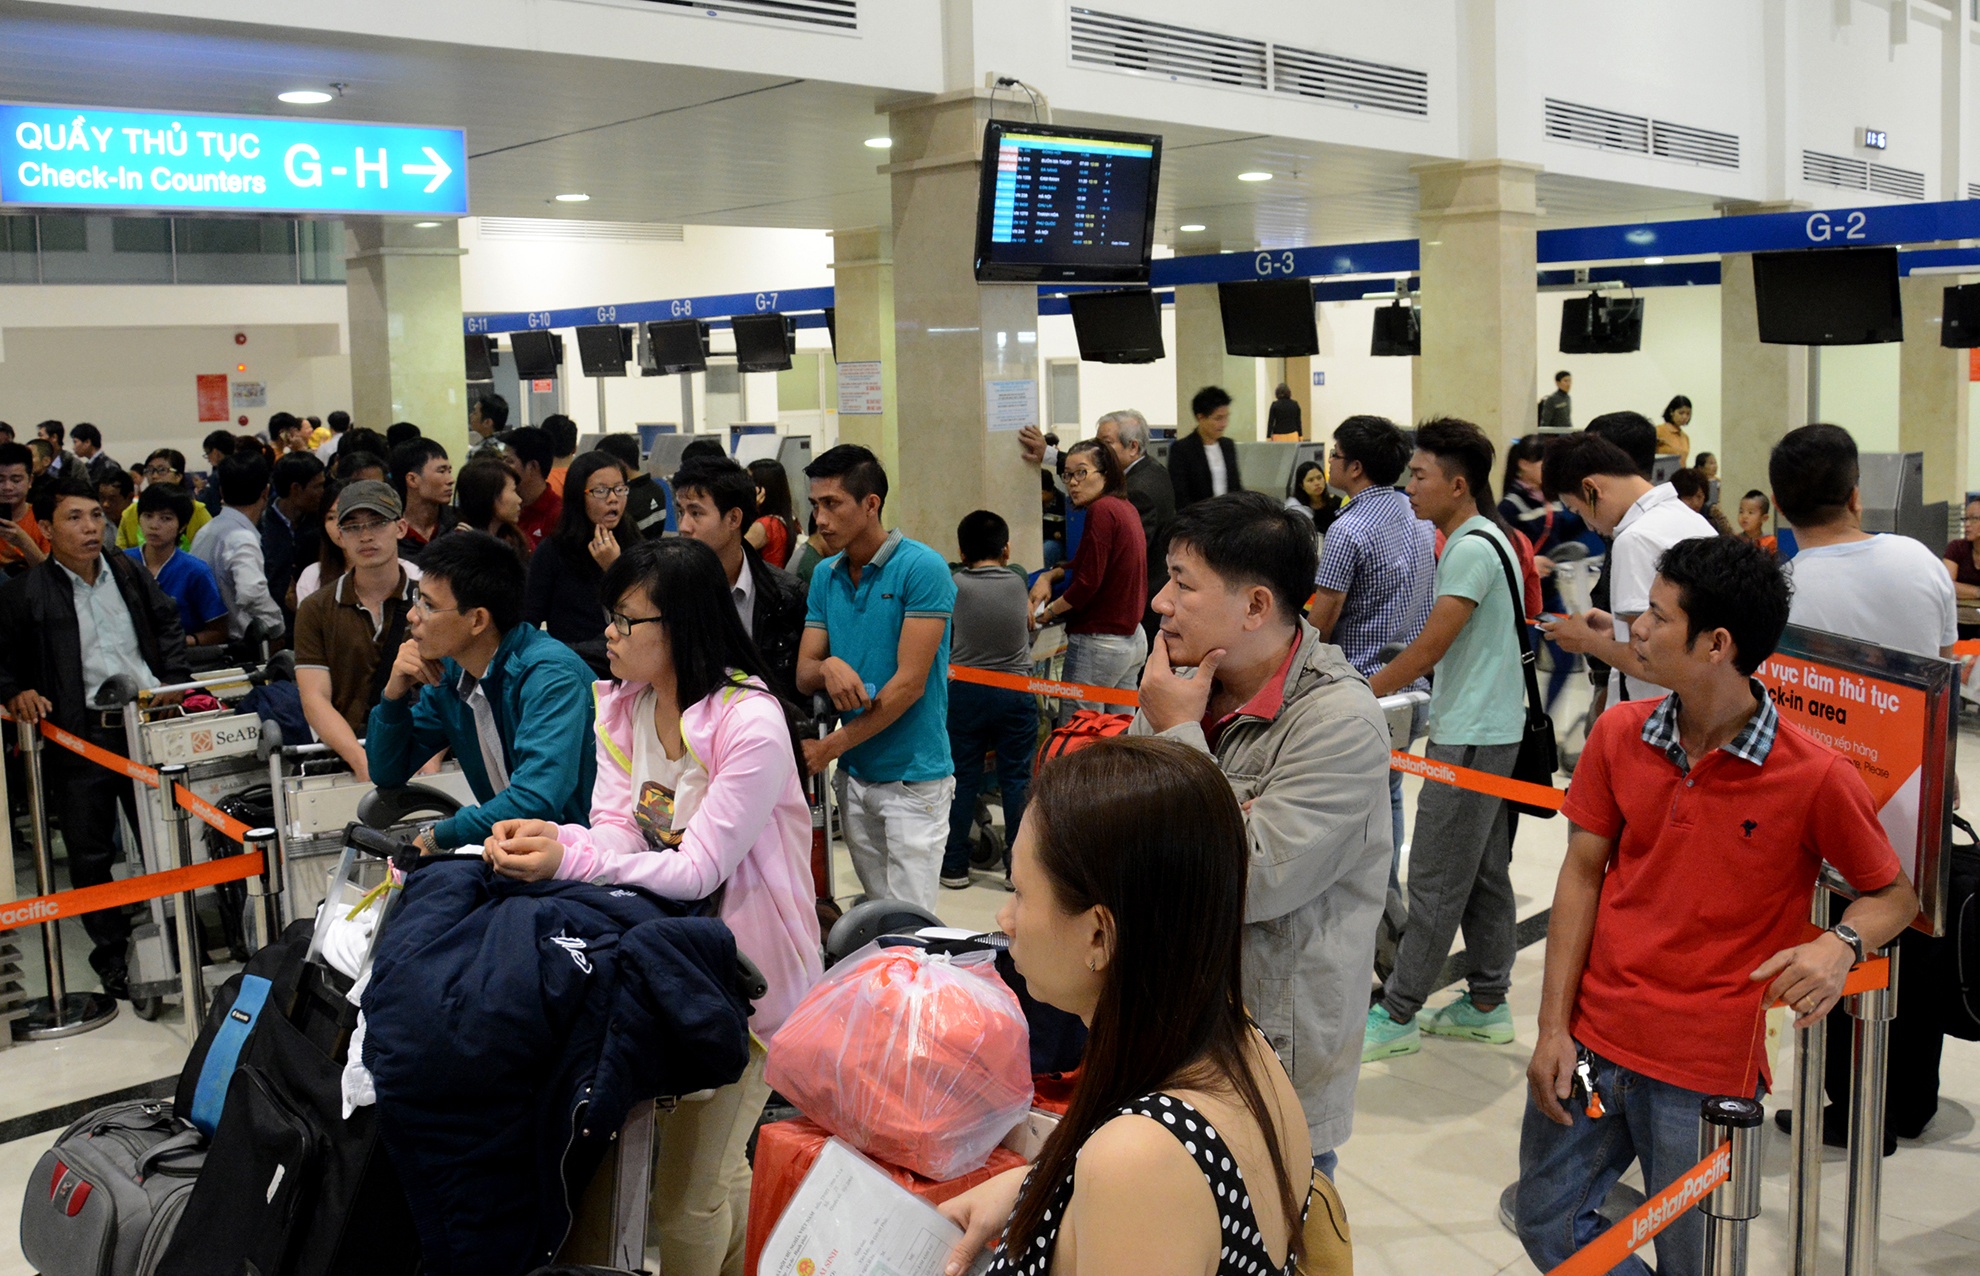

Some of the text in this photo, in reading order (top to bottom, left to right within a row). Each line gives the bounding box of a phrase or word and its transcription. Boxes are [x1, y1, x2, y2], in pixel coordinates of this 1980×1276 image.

[16, 115, 261, 163] QUẦY THỦ TỤC
[18, 161, 267, 194] Check-In Counters
[1806, 211, 1866, 242] G-2
[1255, 251, 1295, 275] G-3
[671, 299, 692, 317] G-8
[755, 293, 778, 311] G-7
[468, 317, 488, 332] G-11
[528, 312, 551, 328] G-10
[597, 306, 616, 322] G-9
[1027, 680, 1084, 699] JetstarPacific
[1771, 662, 1799, 686] vực
[1803, 666, 1834, 694] làm
[1839, 678, 1866, 704] thủ
[1871, 684, 1900, 714] tục
[1768, 686, 1847, 725] ck-in area
[216, 726, 258, 746] SeAB
[1853, 740, 1878, 763] hàng
[1390, 755, 1456, 782] etstarPacific
[1864, 761, 1890, 779] Please
[0, 900, 59, 925] acific
[1627, 1151, 1731, 1249] JetstarPacific
